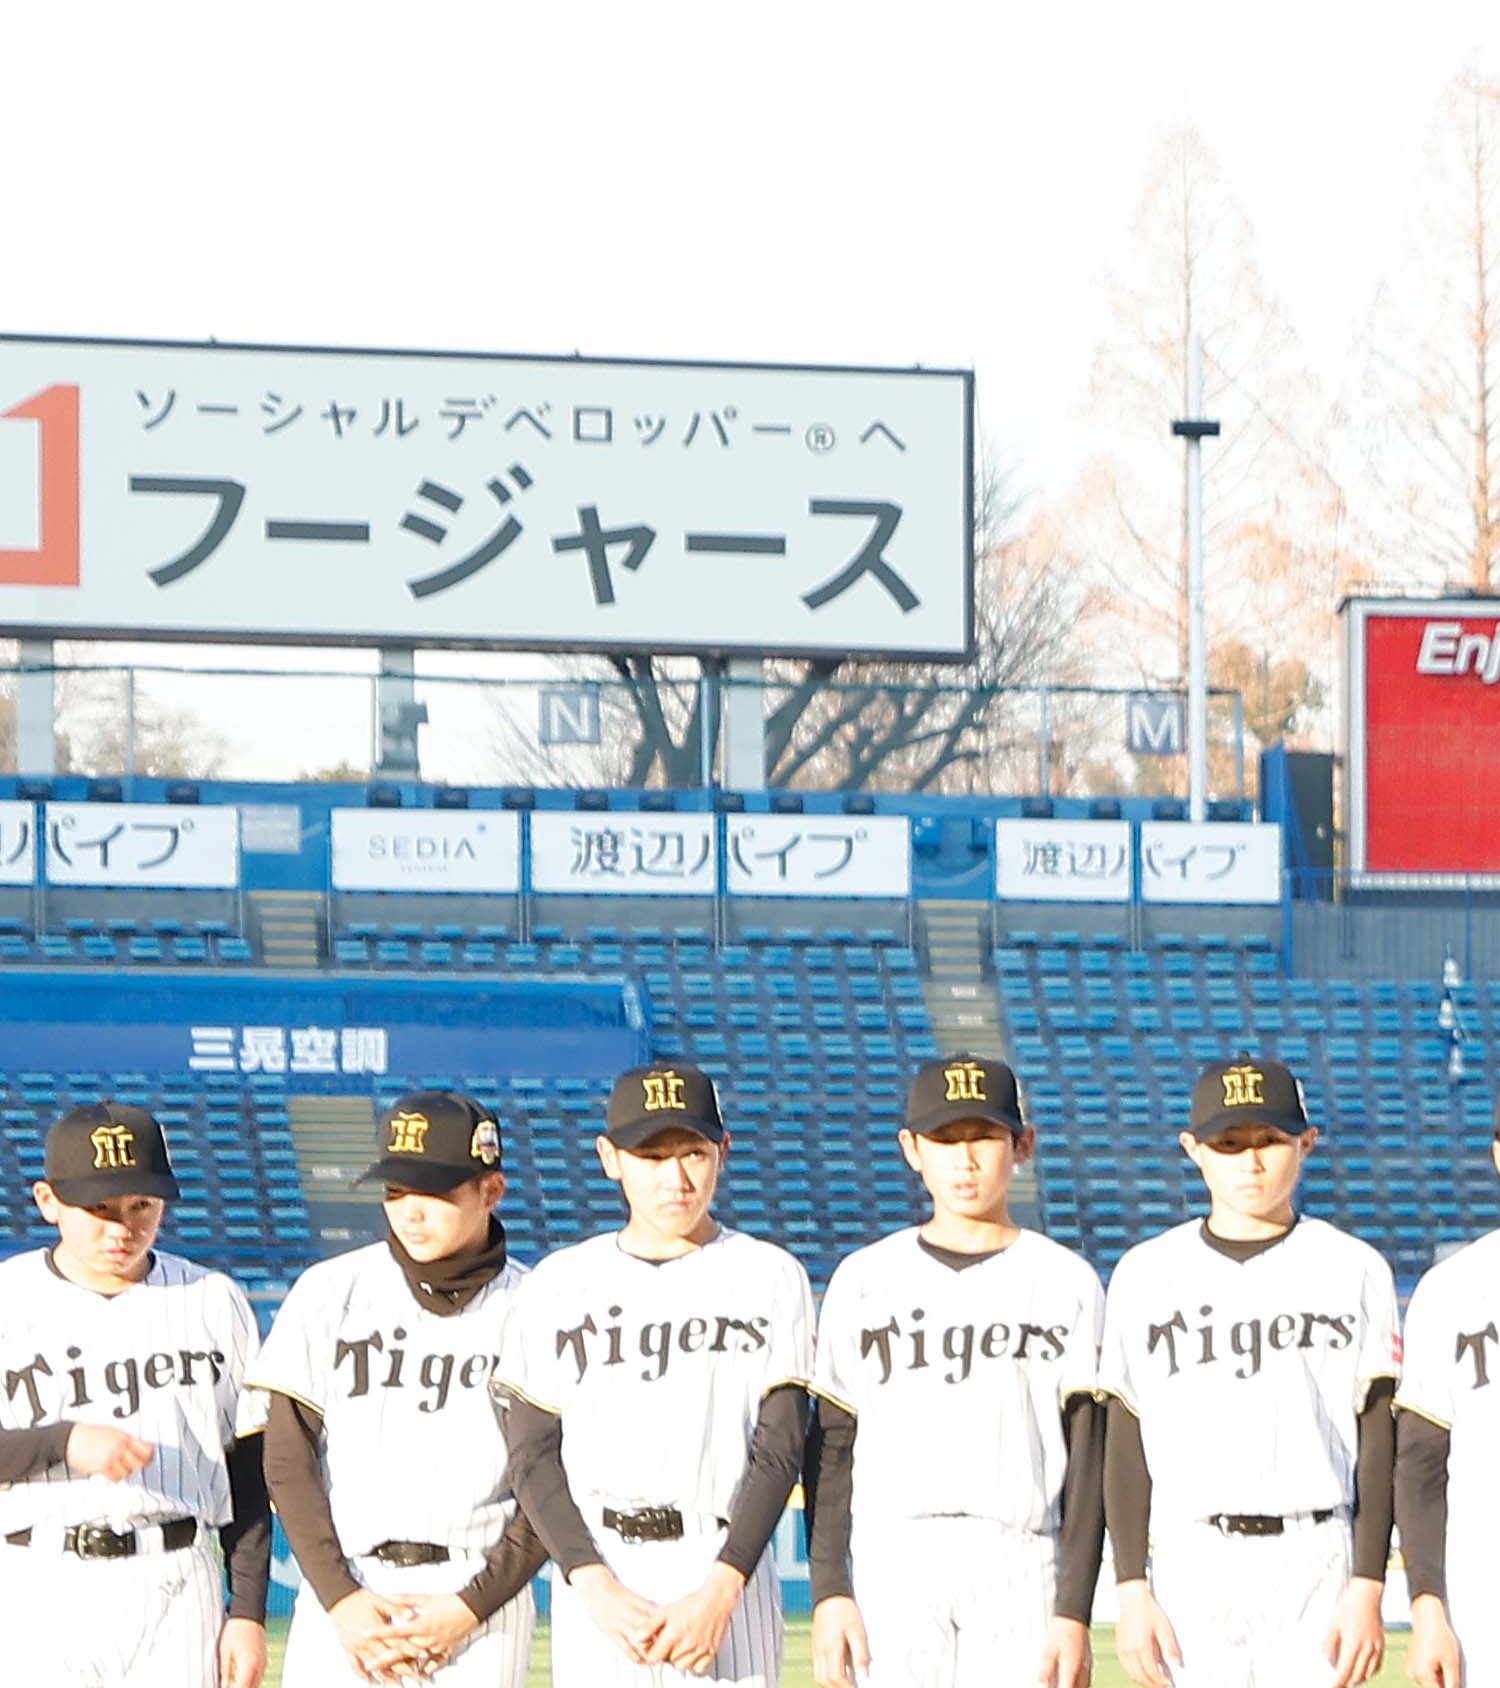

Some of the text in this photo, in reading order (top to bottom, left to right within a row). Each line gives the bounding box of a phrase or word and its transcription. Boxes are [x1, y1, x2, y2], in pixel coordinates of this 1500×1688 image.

[127, 464, 921, 614] フージャース
[551, 698, 592, 738] N
[1132, 704, 1176, 746] M
[0, 815, 194, 868] パイプ
[569, 825, 869, 880] 渡辺パイプ
[189, 1026, 389, 1075] 三晃空調
[333, 1328, 499, 1413] Tige
[556, 1305, 768, 1384] Tigers
[860, 1307, 1069, 1385] Tigers
[1148, 1304, 1357, 1380] Tigers
[3, 1345, 225, 1427] Tigers
